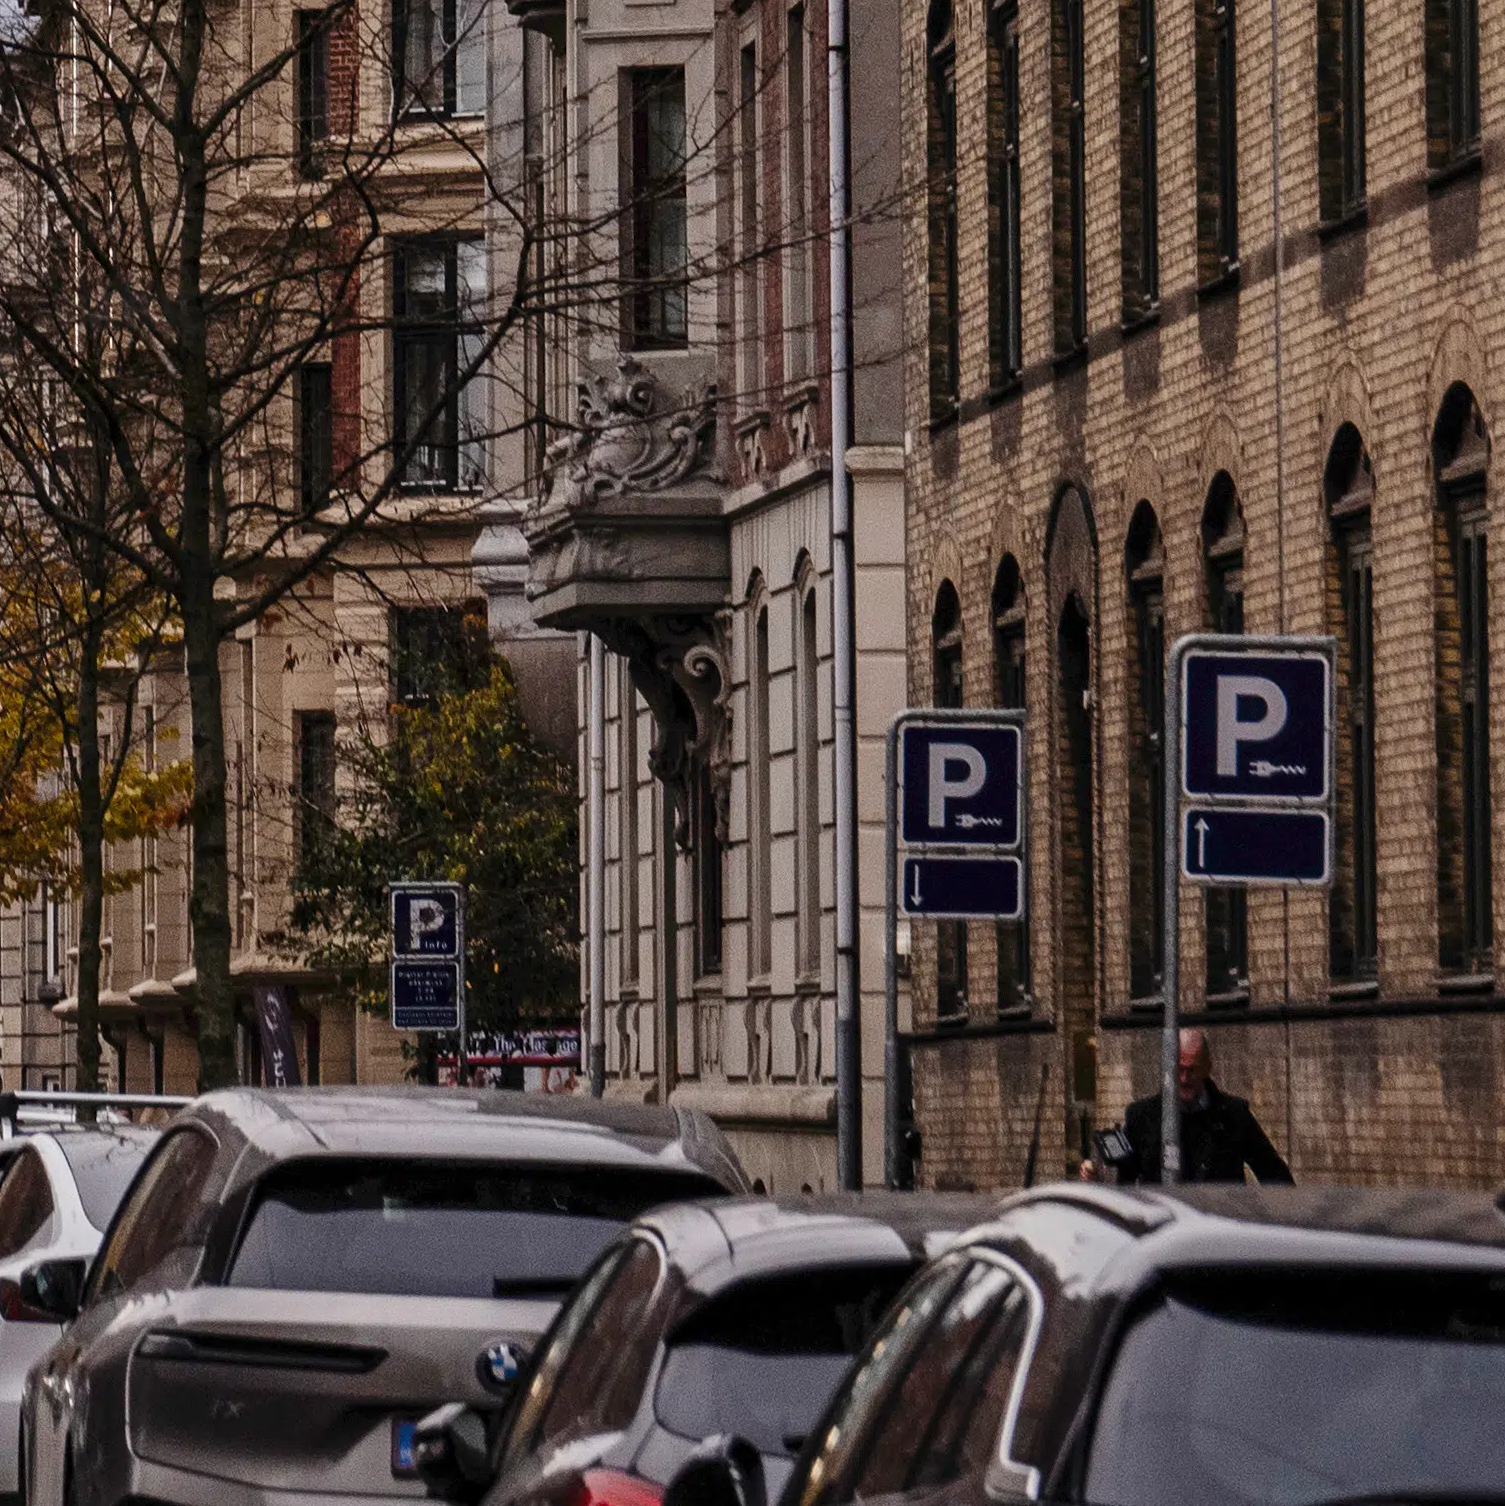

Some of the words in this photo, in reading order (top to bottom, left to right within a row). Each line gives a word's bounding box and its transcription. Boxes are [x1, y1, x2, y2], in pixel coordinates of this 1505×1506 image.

[1216, 675, 1288, 777] P
[928, 742, 987, 828] P
[410, 899, 445, 949] P
